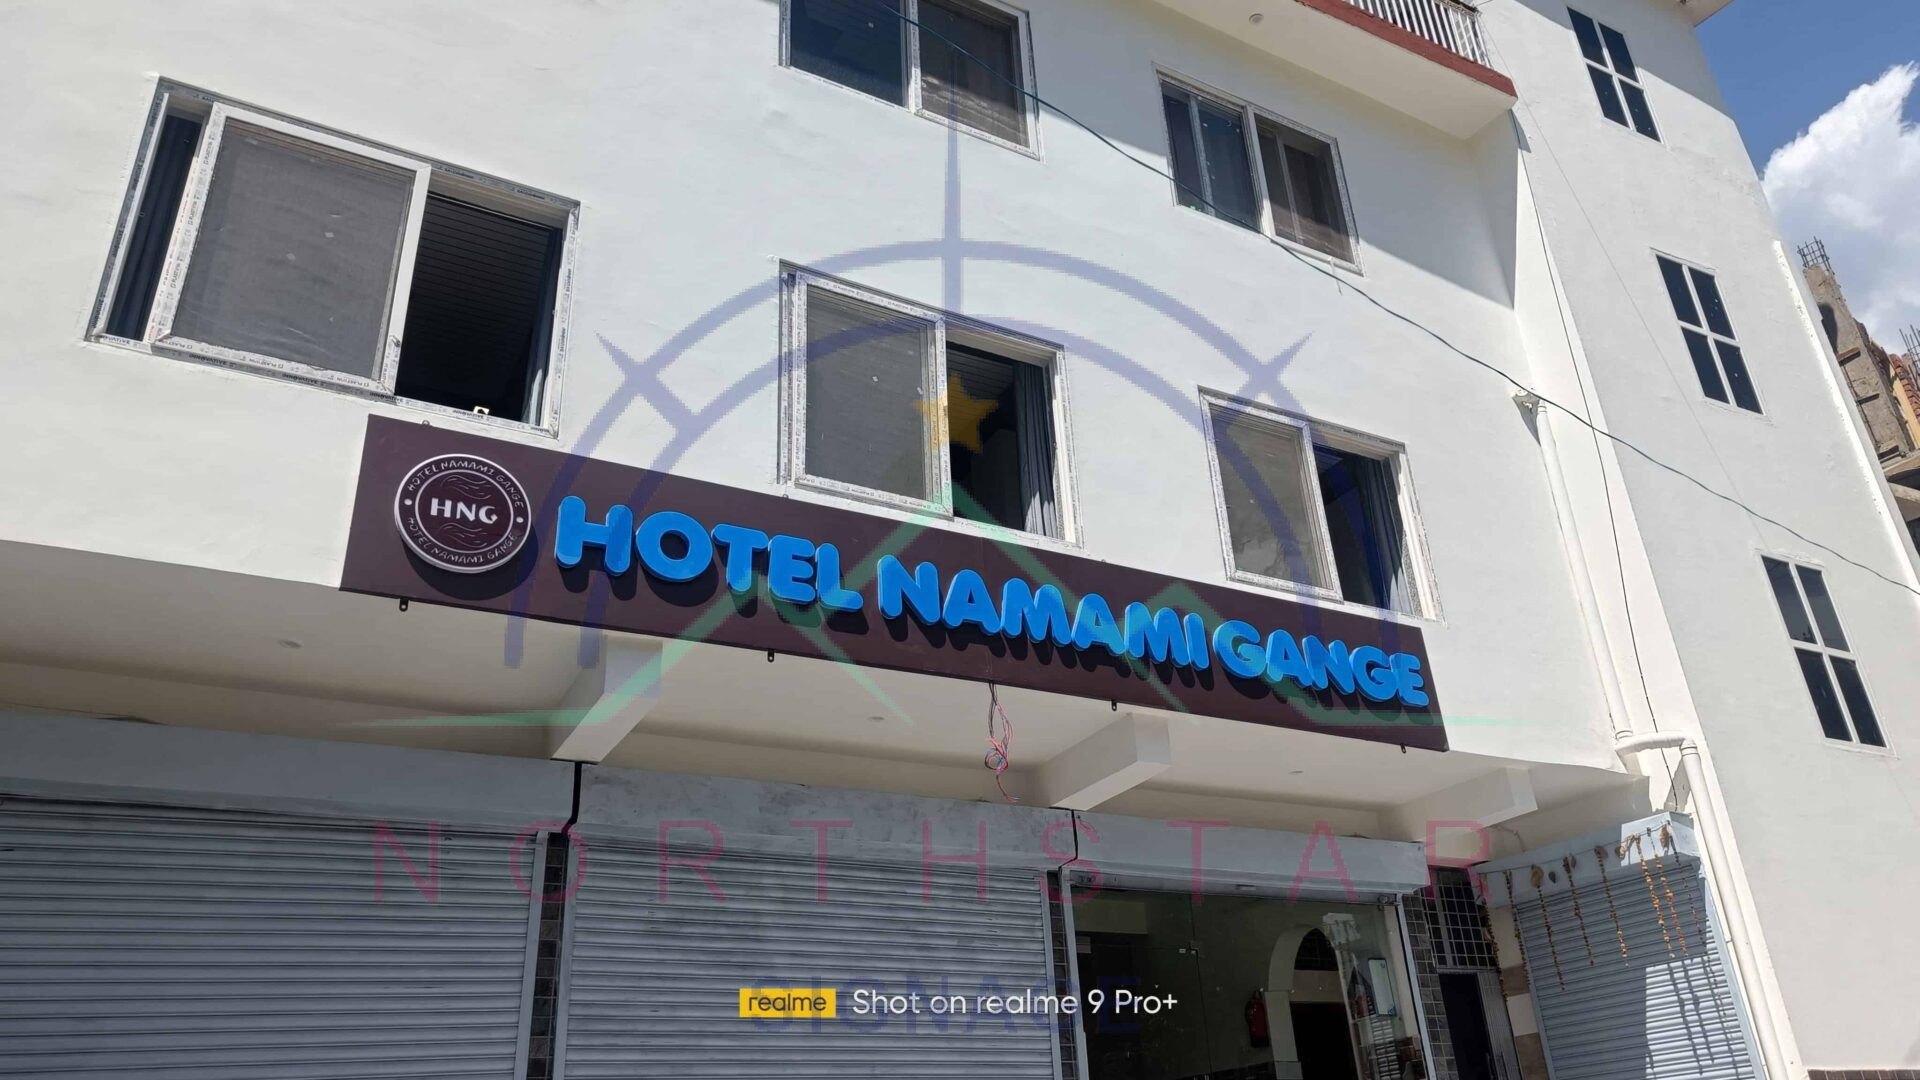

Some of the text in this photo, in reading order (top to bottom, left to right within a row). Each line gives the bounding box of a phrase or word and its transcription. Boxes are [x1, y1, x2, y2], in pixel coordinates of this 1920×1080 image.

[408, 460, 525, 508] HOTEL NAMAMI GANGE
[430, 498, 498, 524] HNG
[408, 517, 518, 564] HOTEL NAMAMI GANGE
[554, 496, 1430, 708] HOTEL NAMAMI GANGE
